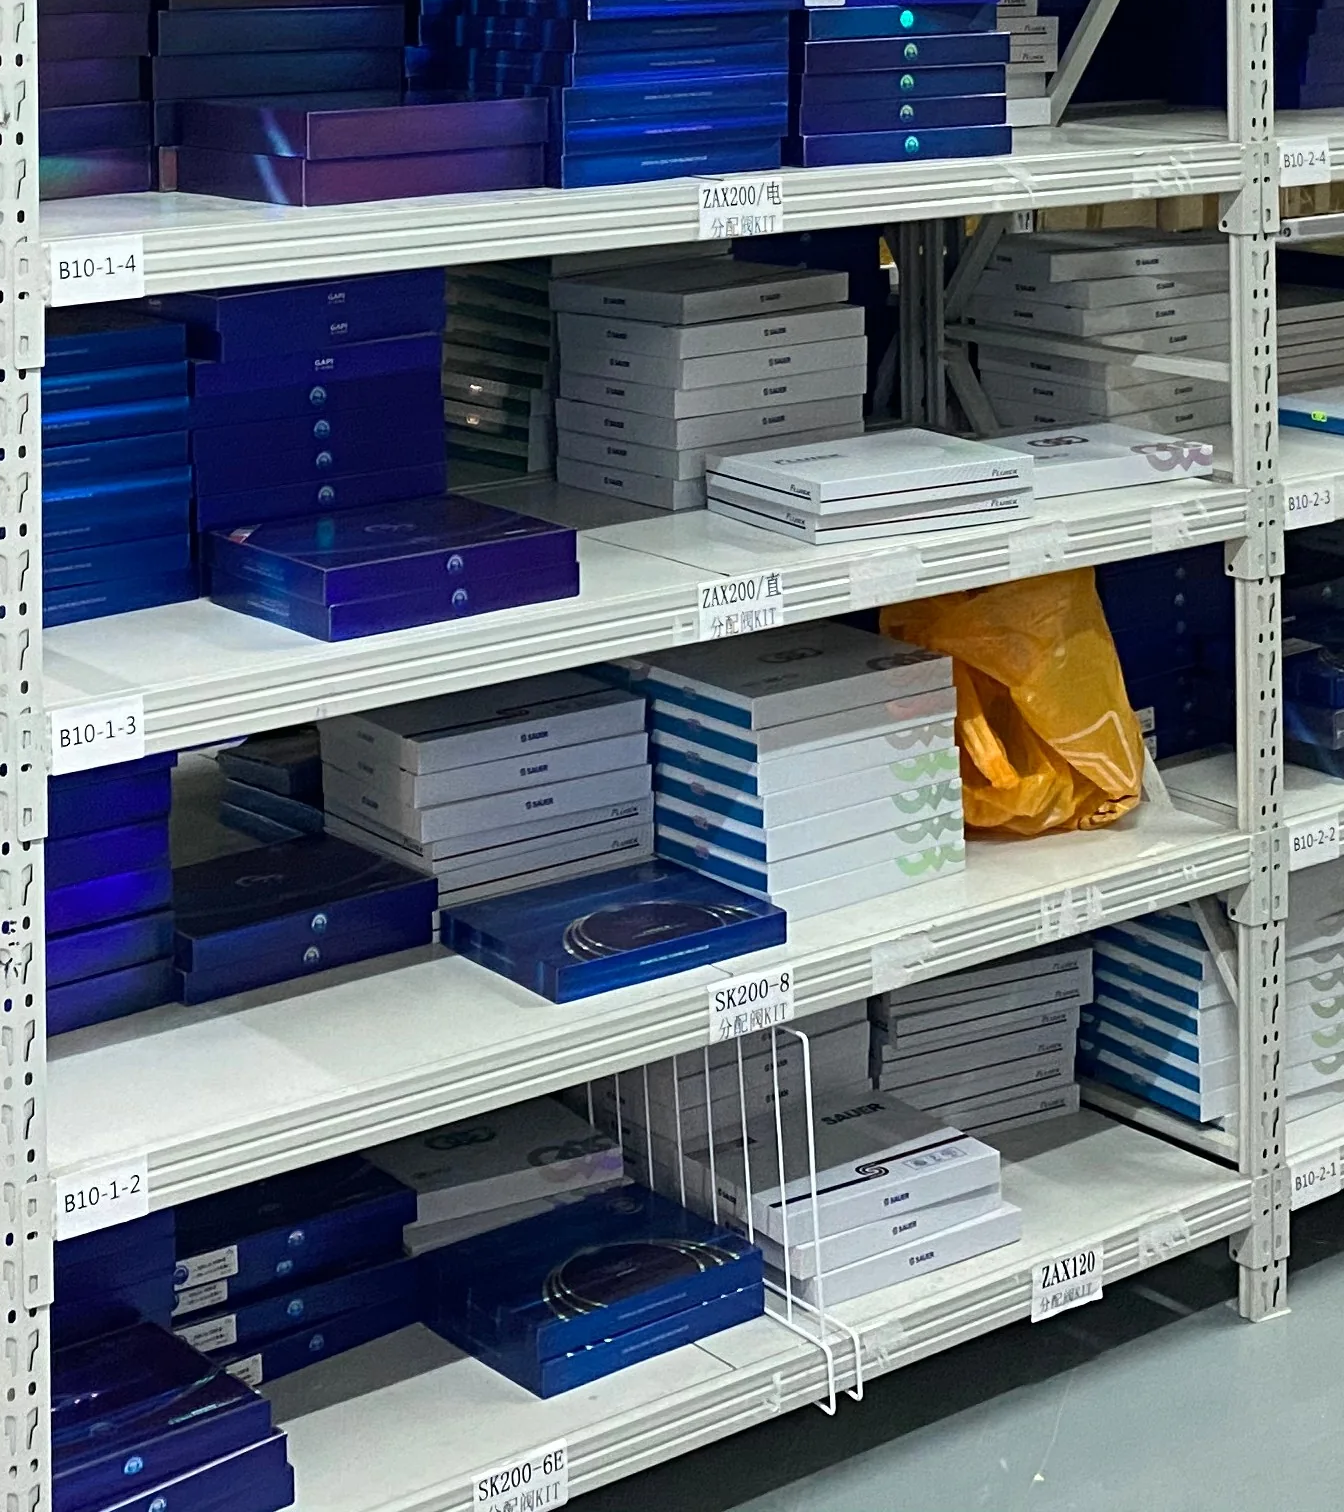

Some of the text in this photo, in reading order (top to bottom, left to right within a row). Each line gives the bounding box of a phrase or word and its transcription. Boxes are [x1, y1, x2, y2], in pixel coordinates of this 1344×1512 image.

[1283, 151, 1327, 169] B10-2-4
[703, 181, 782, 210] ZAX200/电
[57, 253, 137, 280] B10-1-4
[1288, 490, 1332, 511] B10-2-3
[702, 573, 782, 609] ZAX200/直
[58, 715, 138, 749] B10-1-3
[1293, 826, 1337, 852] B10-2-2
[715, 972, 790, 1013] SK200-8
[820, 1101, 887, 1127] SAUER
[1294, 1162, 1337, 1191] B10-2-1
[62, 1174, 142, 1214] B10-1-2
[1041, 1250, 1096, 1290] ZAX120
[478, 1449, 564, 1503] SK200-6E
